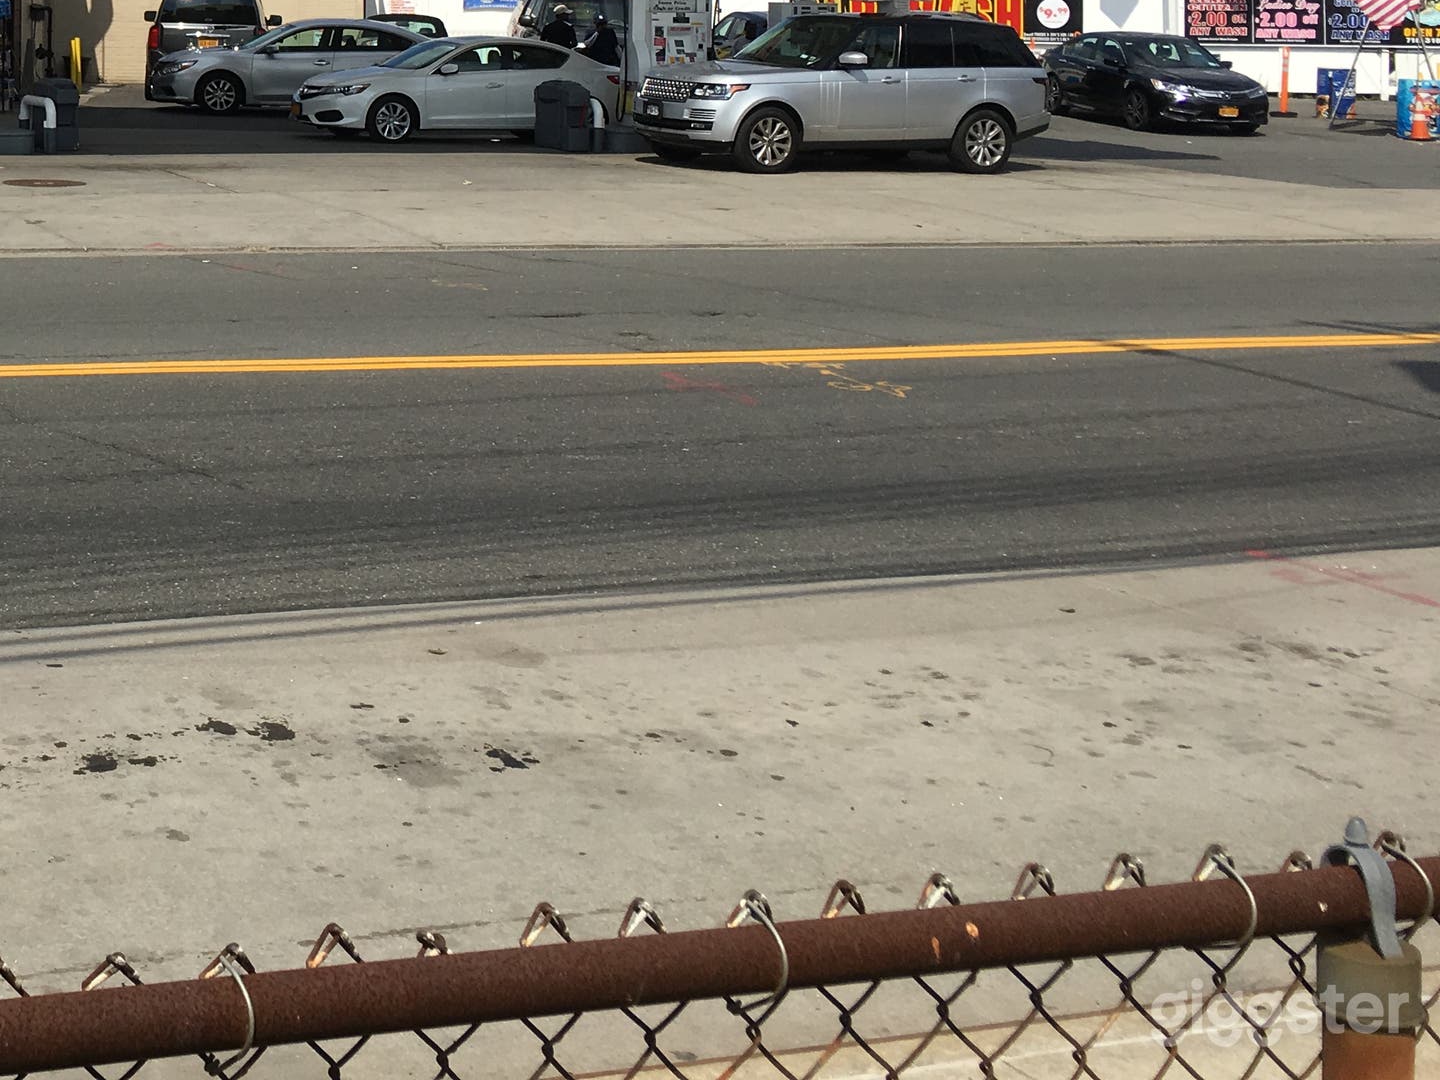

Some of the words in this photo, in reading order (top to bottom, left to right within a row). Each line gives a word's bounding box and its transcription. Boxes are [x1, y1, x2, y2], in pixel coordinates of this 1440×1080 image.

[1190, 27, 1211, 36] ANY
[1215, 27, 1248, 36] WASH
[1331, 29, 1354, 39] ANY
[1356, 29, 1390, 40] WASH
